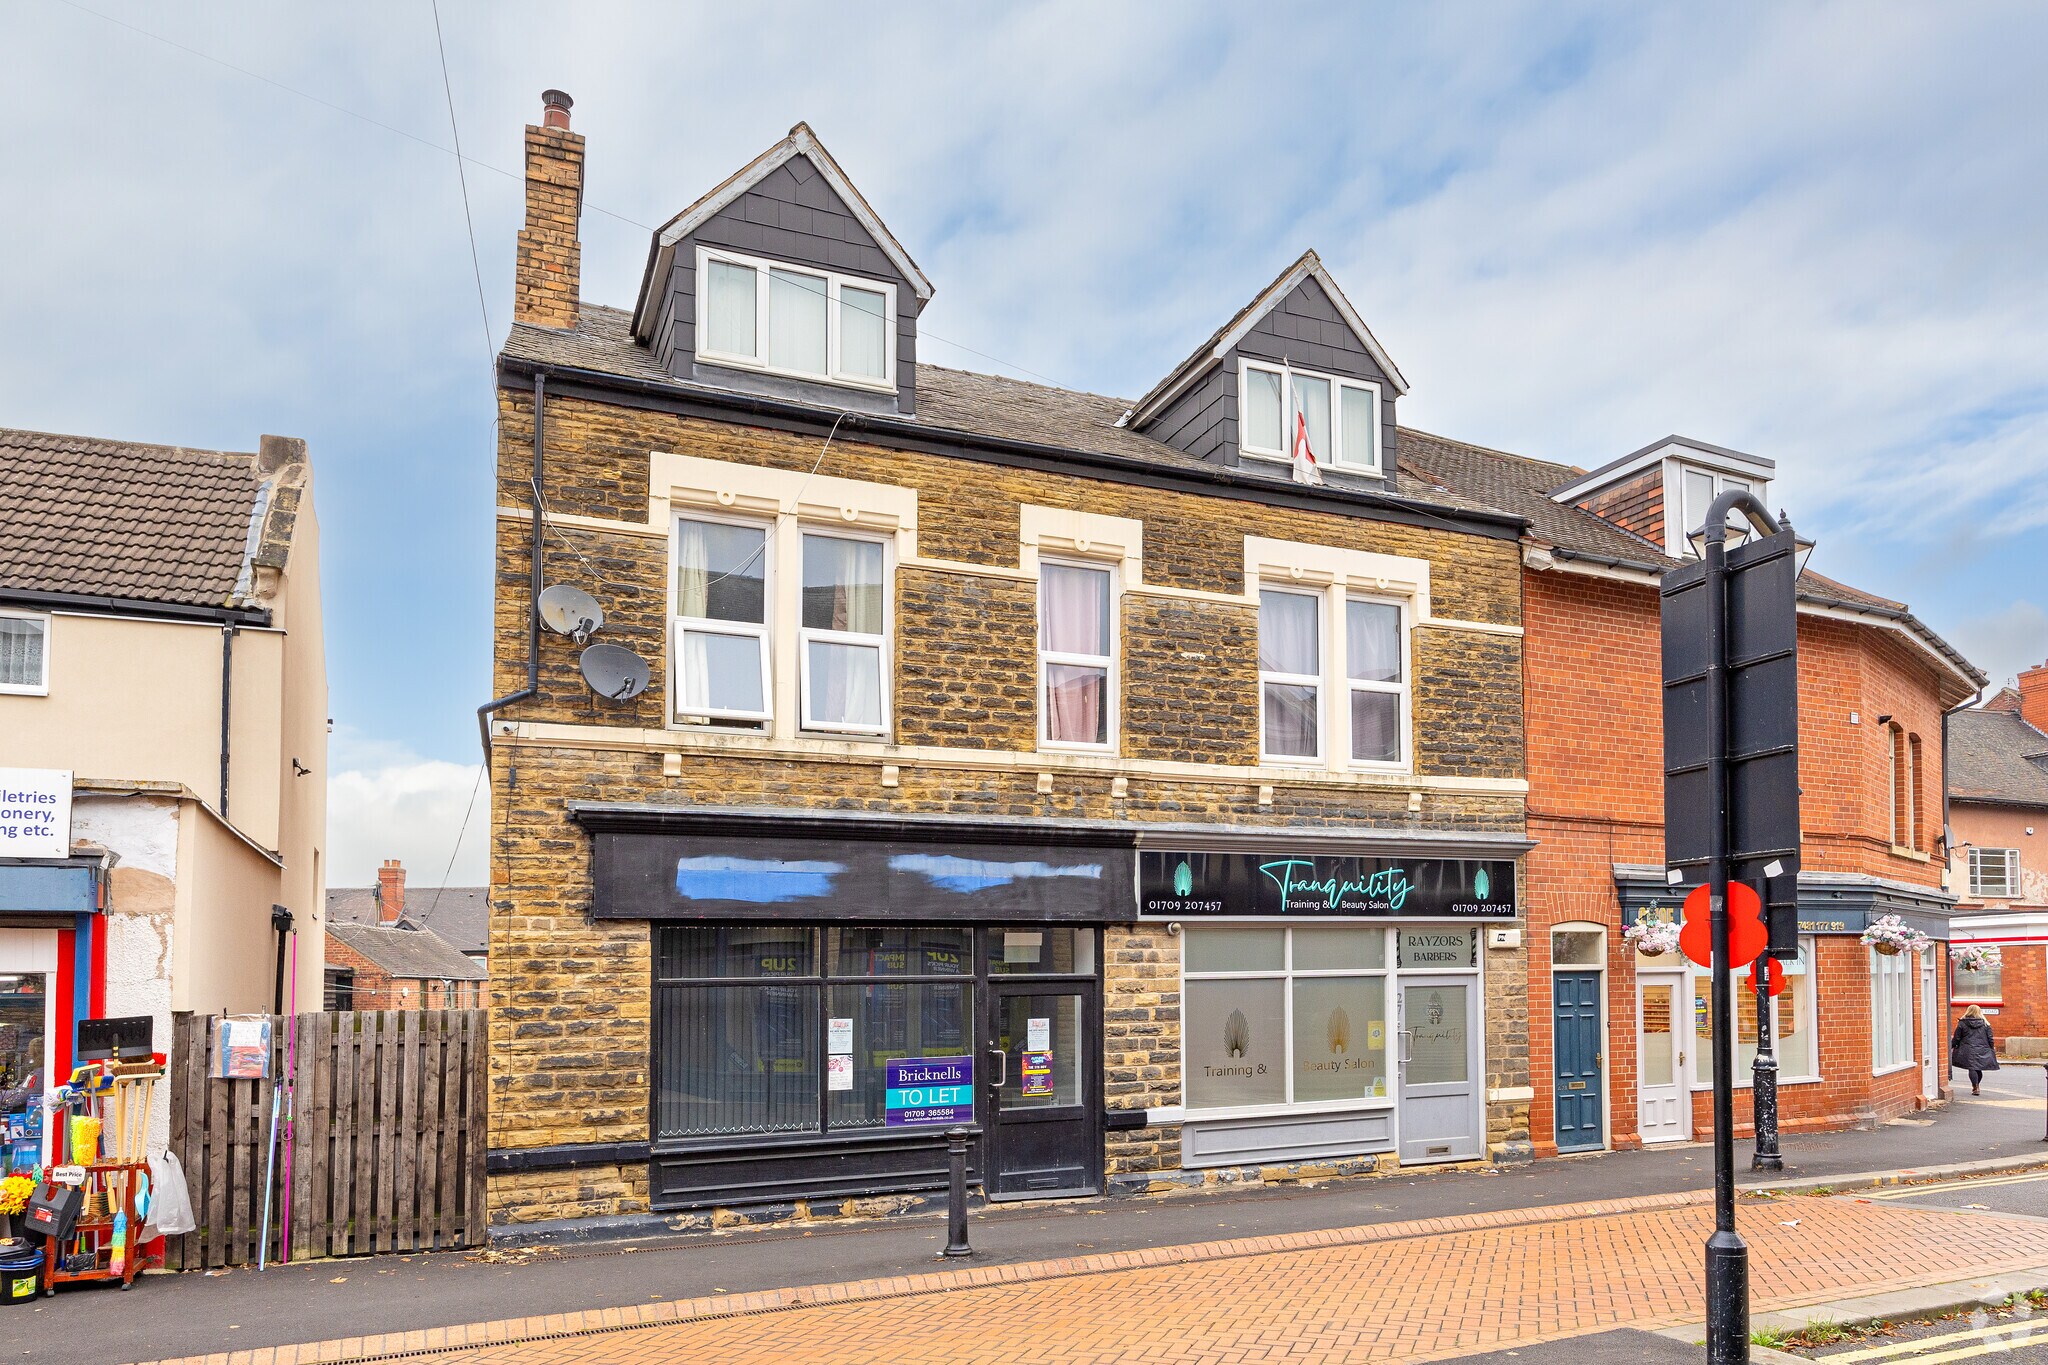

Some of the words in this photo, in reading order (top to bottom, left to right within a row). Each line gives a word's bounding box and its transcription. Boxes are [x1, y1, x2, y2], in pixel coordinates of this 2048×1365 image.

[1, 809, 55, 823] onery,
[23, 825, 54, 837] etc.
[1259, 860, 1415, 912] Tranquility
[1149, 900, 1181, 911] 01709
[1184, 901, 1222, 911] 207457
[1286, 900, 1320, 911] Training
[1322, 901, 1331, 909] &
[1341, 901, 1367, 910] Beauty
[1368, 901, 1389, 909] Salon
[1452, 904, 1478, 913] 01709
[1481, 904, 1511, 913] 207457
[1408, 935, 1464, 947] RAYZORS
[1413, 952, 1457, 962] BARBERS
[1405, 1026, 1462, 1046] Tranquility
[1204, 1065, 1253, 1078] Training
[1257, 1063, 1267, 1075] &
[1303, 1059, 1341, 1073] Beauty
[1344, 1057, 1375, 1070] Salon
[899, 1066, 961, 1082] Bricknells
[898, 1089, 923, 1105] TO
[929, 1087, 960, 1104] LET
[904, 1110, 925, 1118] 01709
[928, 1108, 954, 1116] 365584
